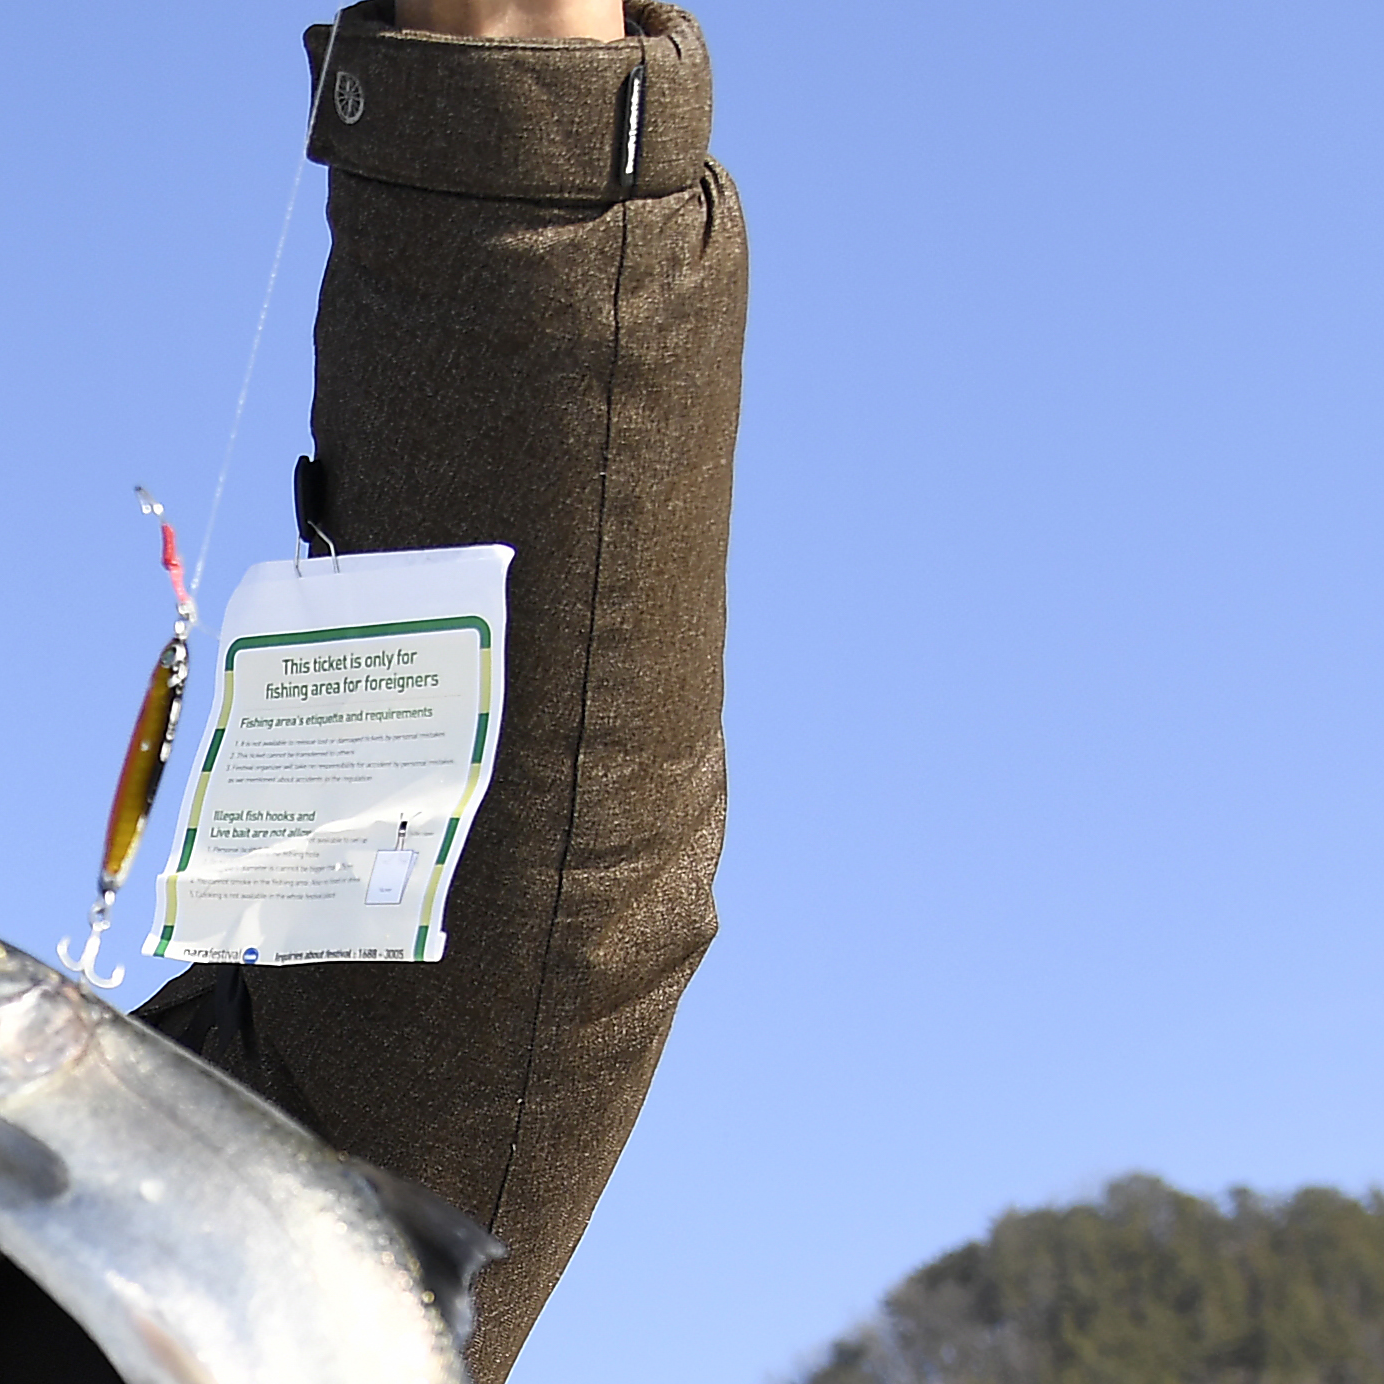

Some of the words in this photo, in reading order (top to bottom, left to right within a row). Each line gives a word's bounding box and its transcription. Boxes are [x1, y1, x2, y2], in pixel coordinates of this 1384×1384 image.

[282, 658, 311, 676] This
[313, 655, 347, 673] ticket
[350, 653, 362, 670] is
[365, 651, 394, 671] only
[397, 649, 417, 666] for
[266, 682, 308, 701] fishing
[311, 683, 341, 697] area
[343, 677, 362, 694] for
[365, 673, 438, 693] foreigners
[240, 717, 273, 730] Fishing
[275, 715, 304, 727] area's
[346, 710, 363, 722] and
[365, 707, 433, 723] requirements
[214, 810, 243, 824] Illegal
[245, 810, 264, 821] fish
[265, 810, 295, 821] hooks
[296, 810, 316, 821] and
[210, 827, 230, 838] Live
[232, 827, 251, 838] bait
[251, 829, 269, 838] are
[269, 828, 287, 837] not
